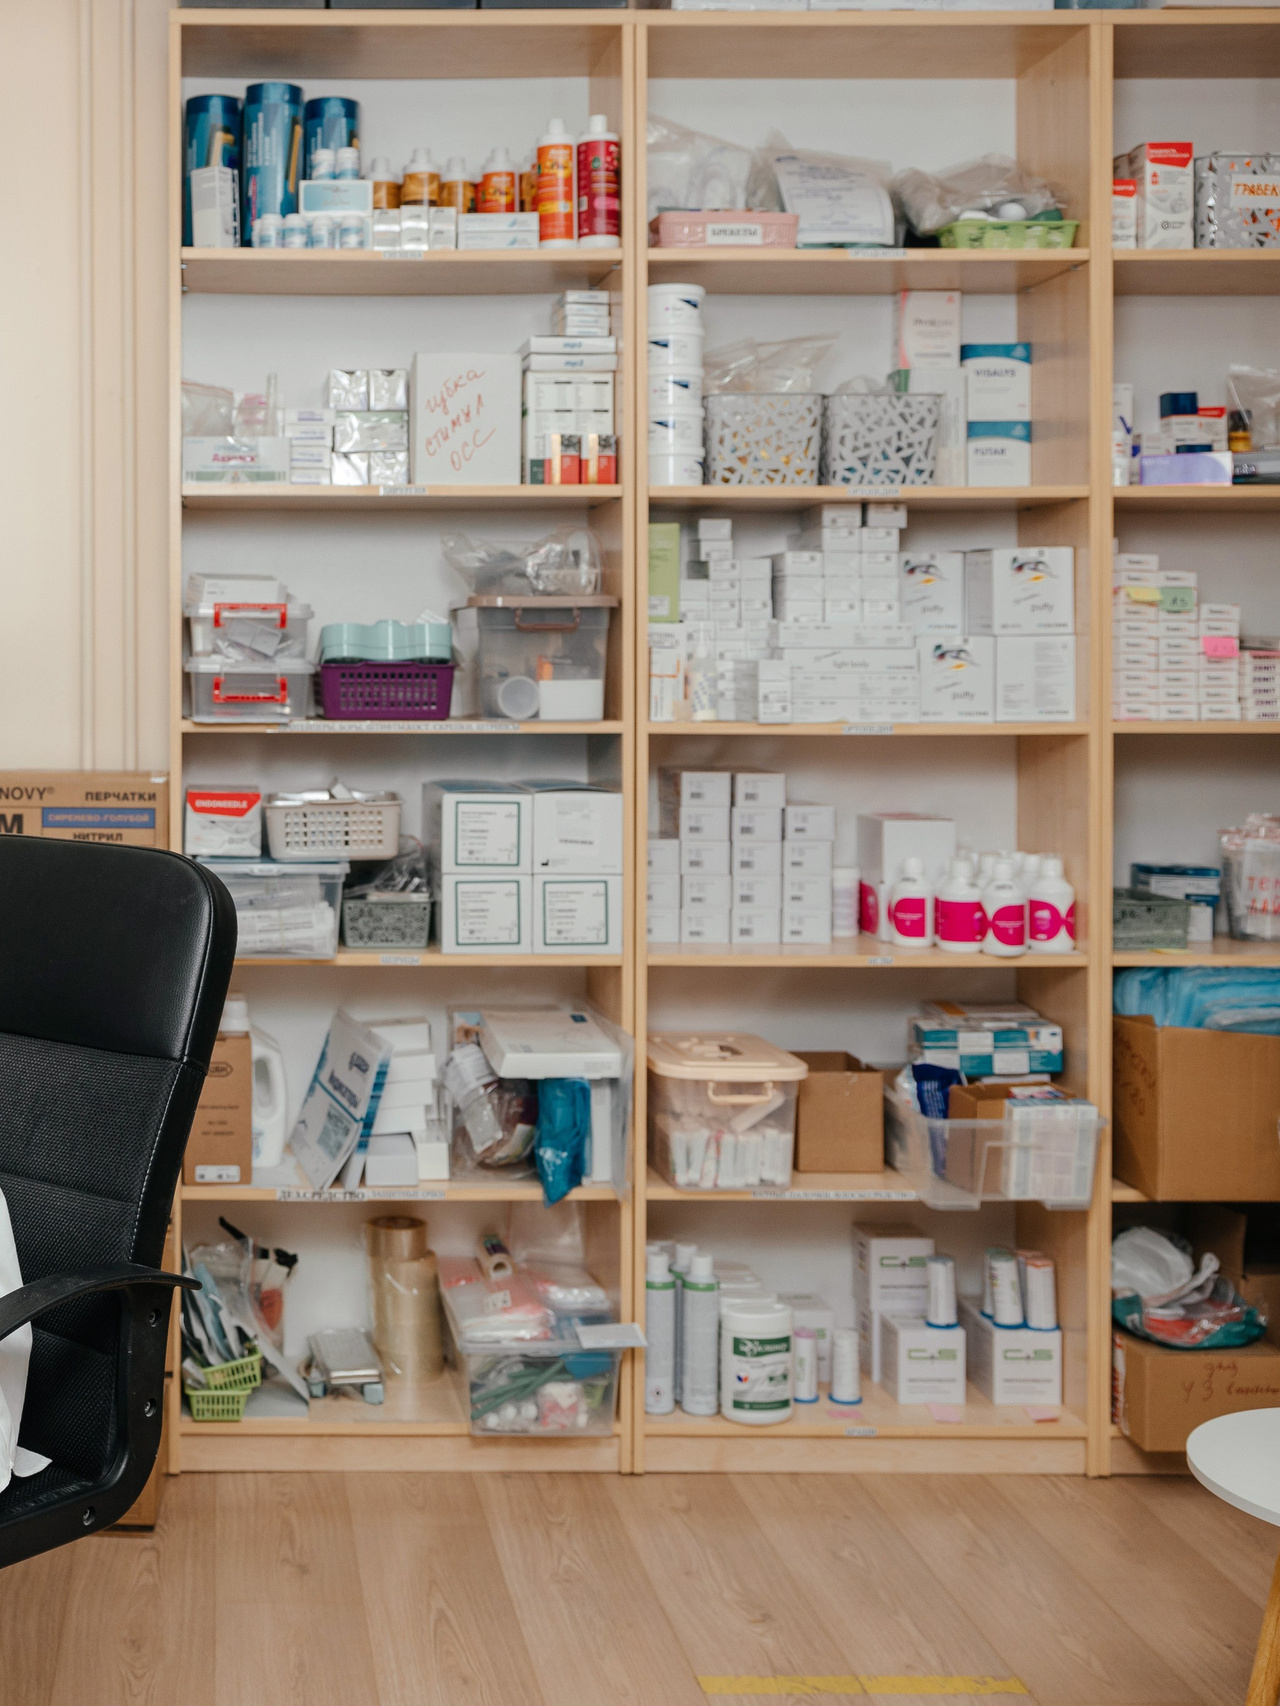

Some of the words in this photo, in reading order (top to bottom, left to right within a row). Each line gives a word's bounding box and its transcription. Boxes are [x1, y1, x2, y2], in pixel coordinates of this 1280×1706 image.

[84, 791, 157, 802] ПЕРЧАТКИ
[48, 813, 149, 823] СИРЕНЕВО-ГОЛУБОЙ
[73, 832, 123, 843] НИТРИЛ
